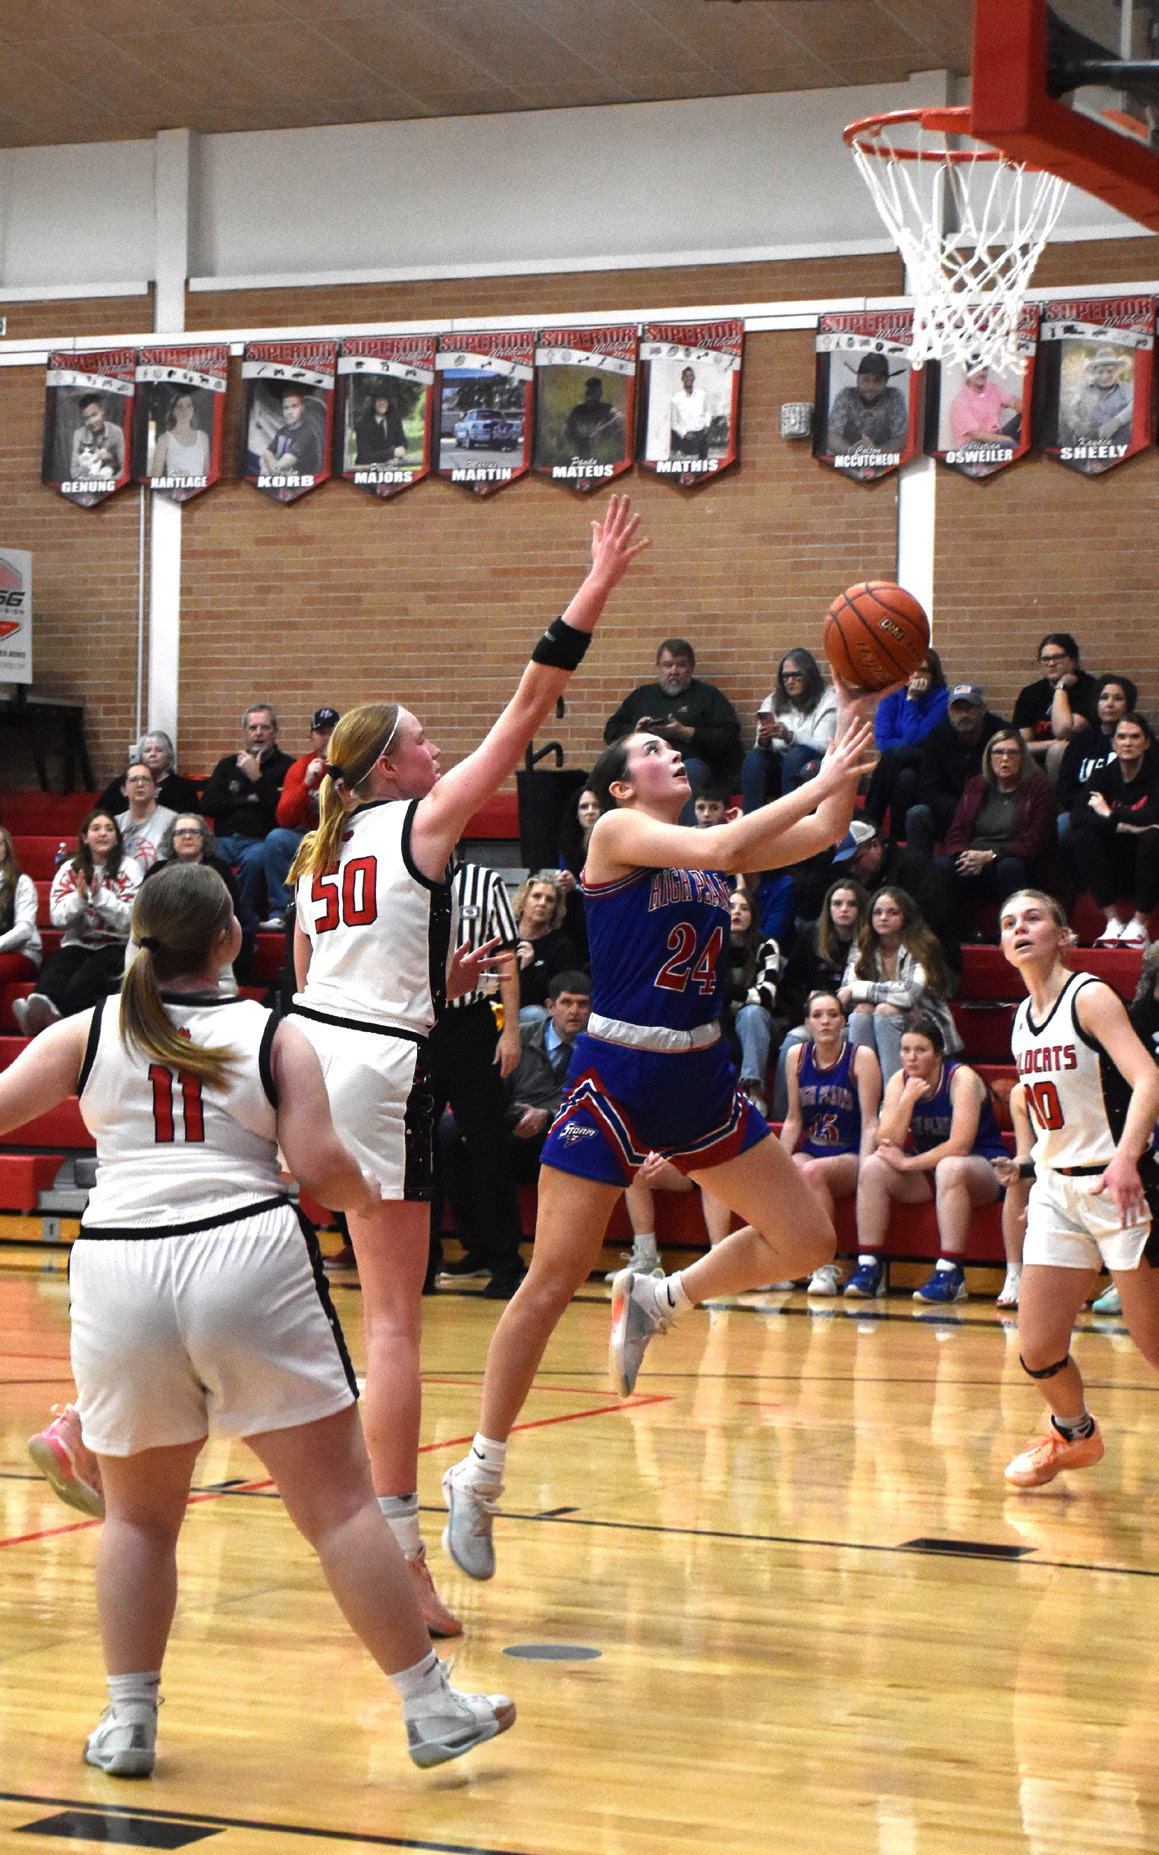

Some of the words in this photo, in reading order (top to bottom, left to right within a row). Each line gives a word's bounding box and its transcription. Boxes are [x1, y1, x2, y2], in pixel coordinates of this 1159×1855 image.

[1047, 298, 1151, 320] SUPERIOR
[541, 326, 637, 346] SUPERIOR
[645, 322, 739, 341] SUPERIOR
[342, 337, 432, 355] SUPERIOR
[440, 332, 532, 350] SUPERIOR
[834, 453, 900, 468] MCCUTCHEON
[946, 449, 1013, 464] OSWEILER
[1060, 444, 1128, 460] SHEELY
[552, 464, 614, 479] MATEUS
[656, 459, 719, 473] MATHIS
[150, 475, 208, 488] HARTLAGE
[257, 475, 315, 488] KORB
[354, 470, 413, 484] MAJORS
[451, 468, 512, 482] MARTIN
[311, 855, 378, 935] 50
[648, 867, 693, 913] HIGH
[653, 921, 724, 996] 24
[147, 1063, 206, 1144] 11
